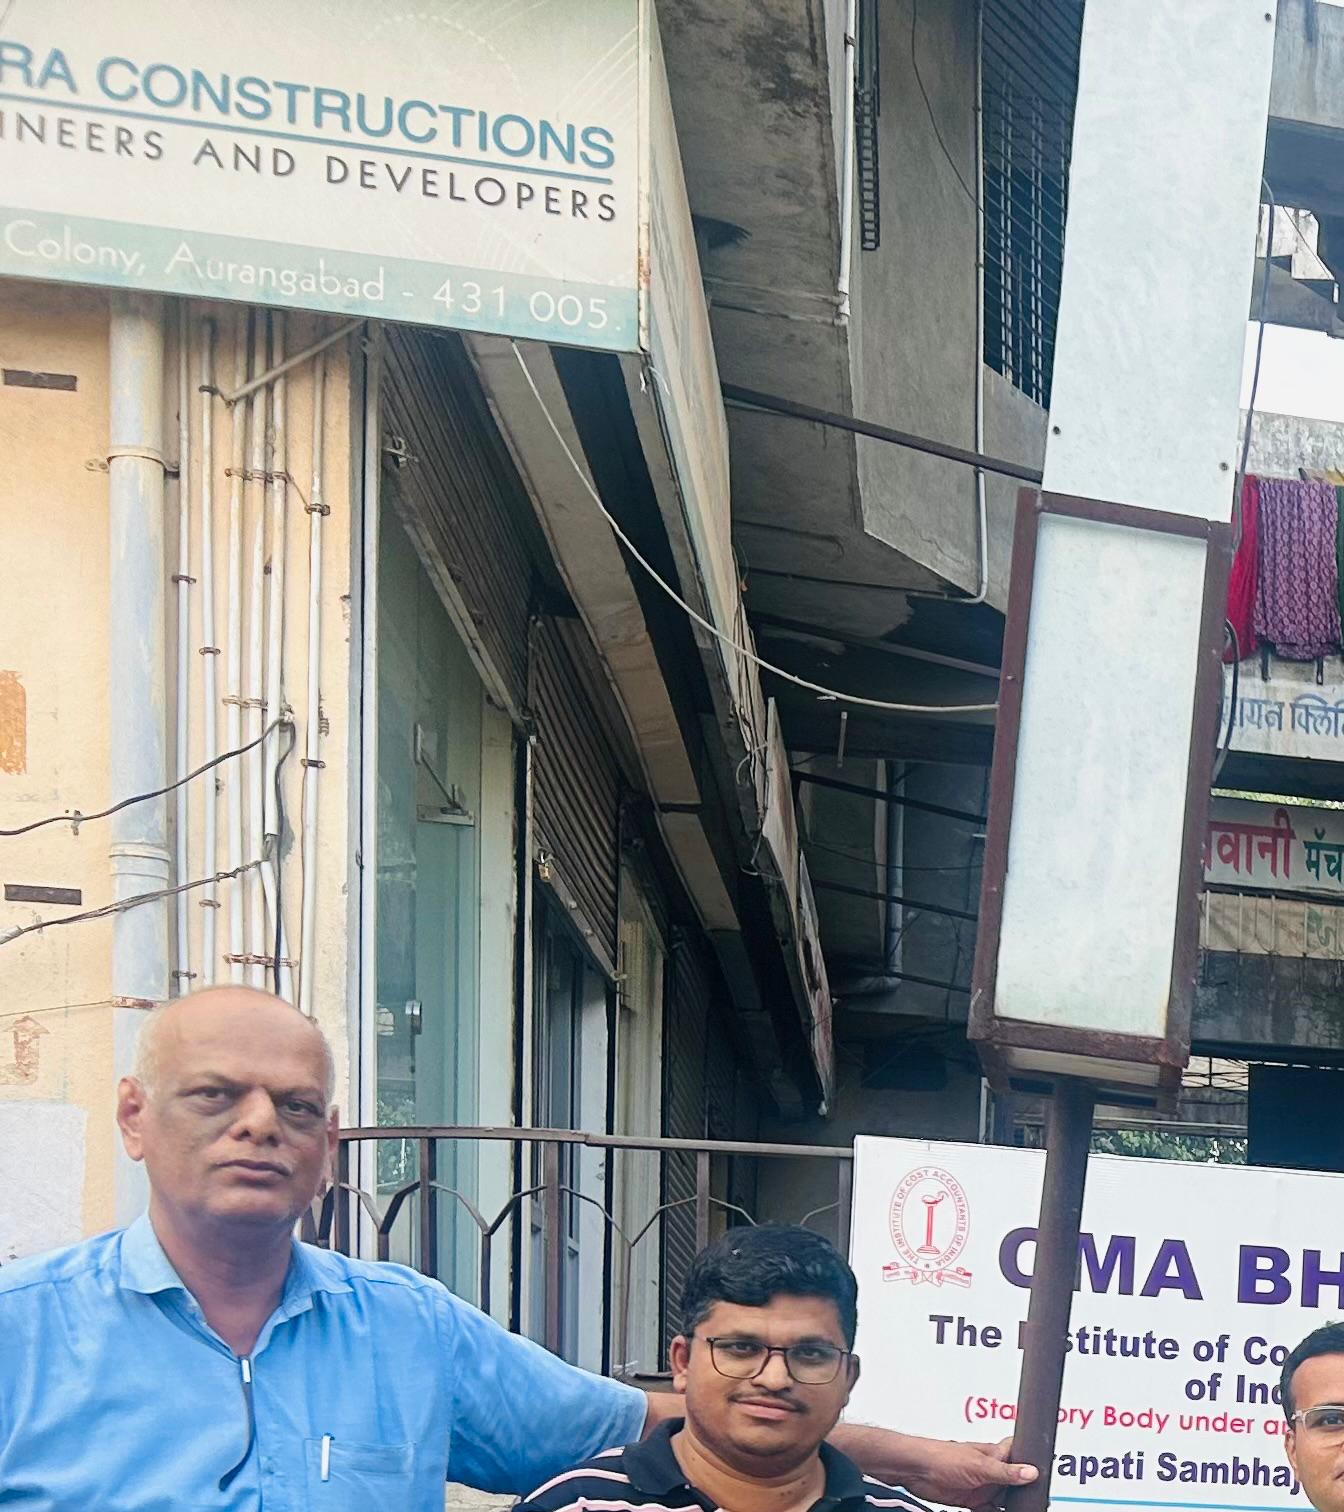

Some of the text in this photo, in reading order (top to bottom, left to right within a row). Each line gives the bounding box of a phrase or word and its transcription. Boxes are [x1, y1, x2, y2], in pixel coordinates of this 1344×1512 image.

[96, 56, 616, 170] CONSTRUCTIONS
[193, 138, 297, 177] AND
[326, 155, 617, 223] DEVELOPERS
[4, 219, 147, 278] Colony,
[164, 241, 384, 302] Aurangabad
[433, 285, 505, 319] 431
[929, 1315, 1001, 1349] The
[1193, 1334, 1230, 1363] of
[1243, 1336, 1290, 1367] Co
[1184, 1372, 1221, 1402] of
[964, 1396, 1094, 1429] (Staory
[1103, 1406, 1171, 1435] Body
[1179, 1413, 1255, 1435] under
[1157, 1452, 1301, 1495] Sambhaj
